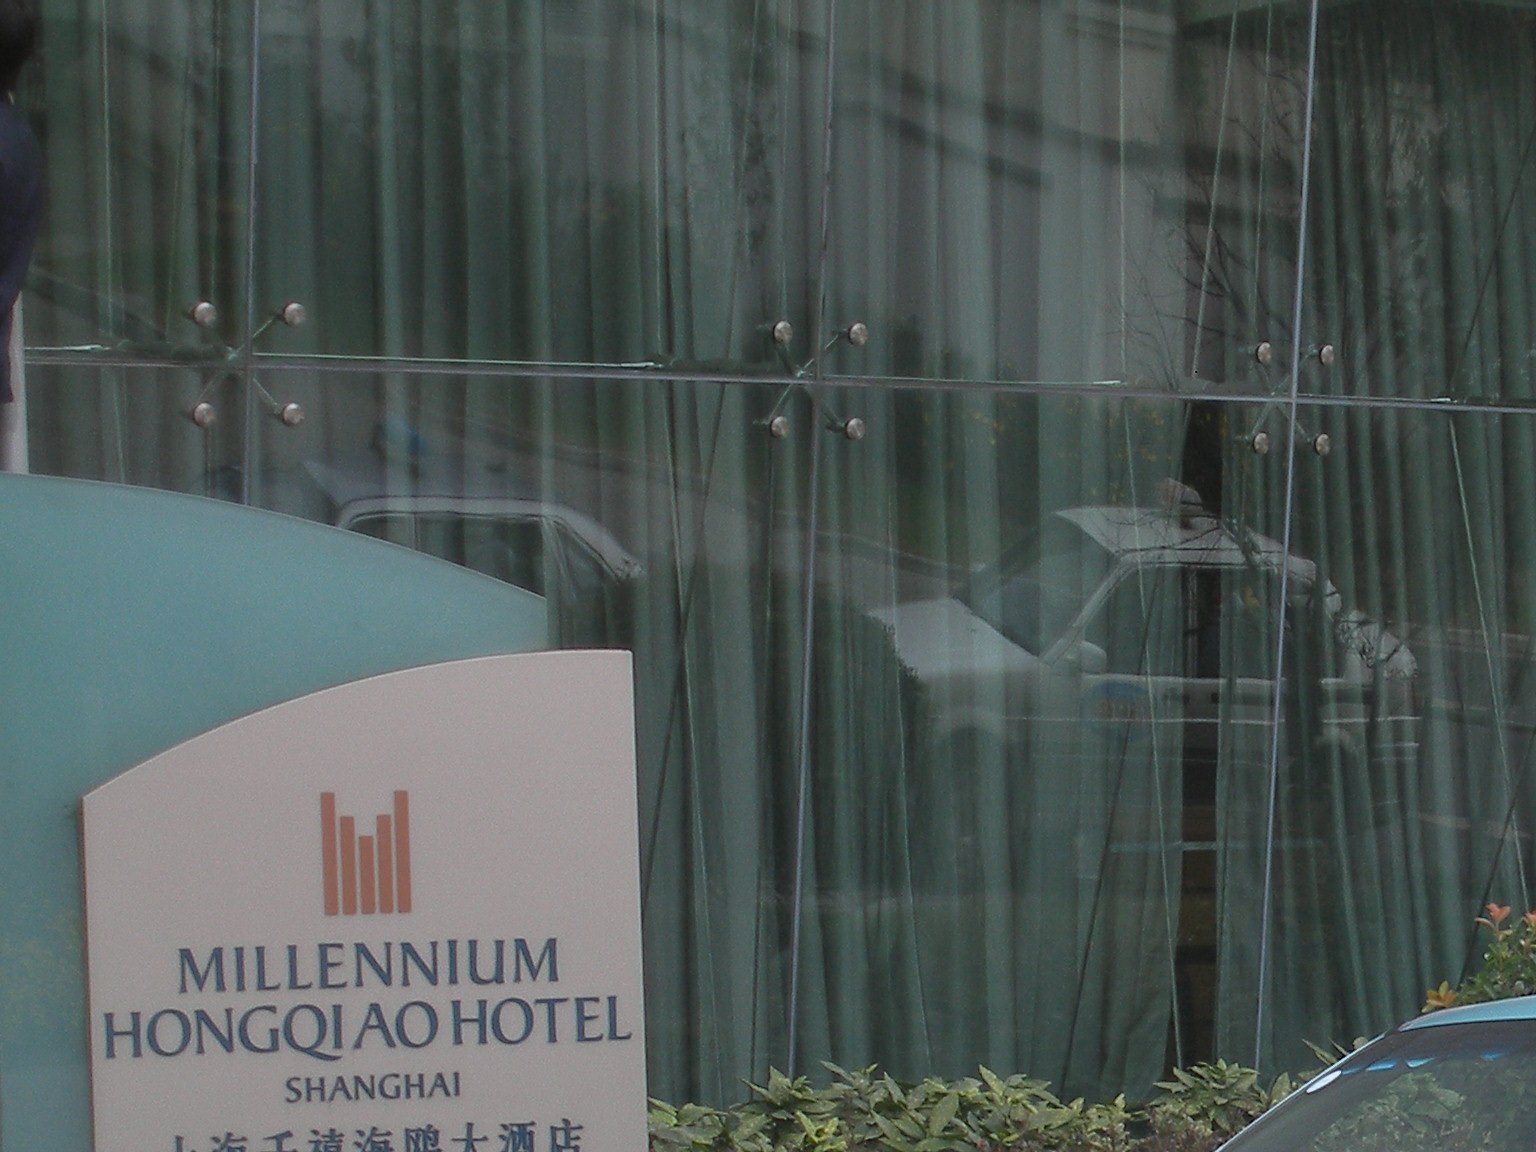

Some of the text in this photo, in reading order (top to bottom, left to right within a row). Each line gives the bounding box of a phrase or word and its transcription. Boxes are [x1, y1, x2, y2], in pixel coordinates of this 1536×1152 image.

[177, 937, 560, 994] MILLENNIUM
[104, 995, 633, 1061] HONGQIAO HOTEL
[285, 1071, 462, 1103] SHANGHAI
